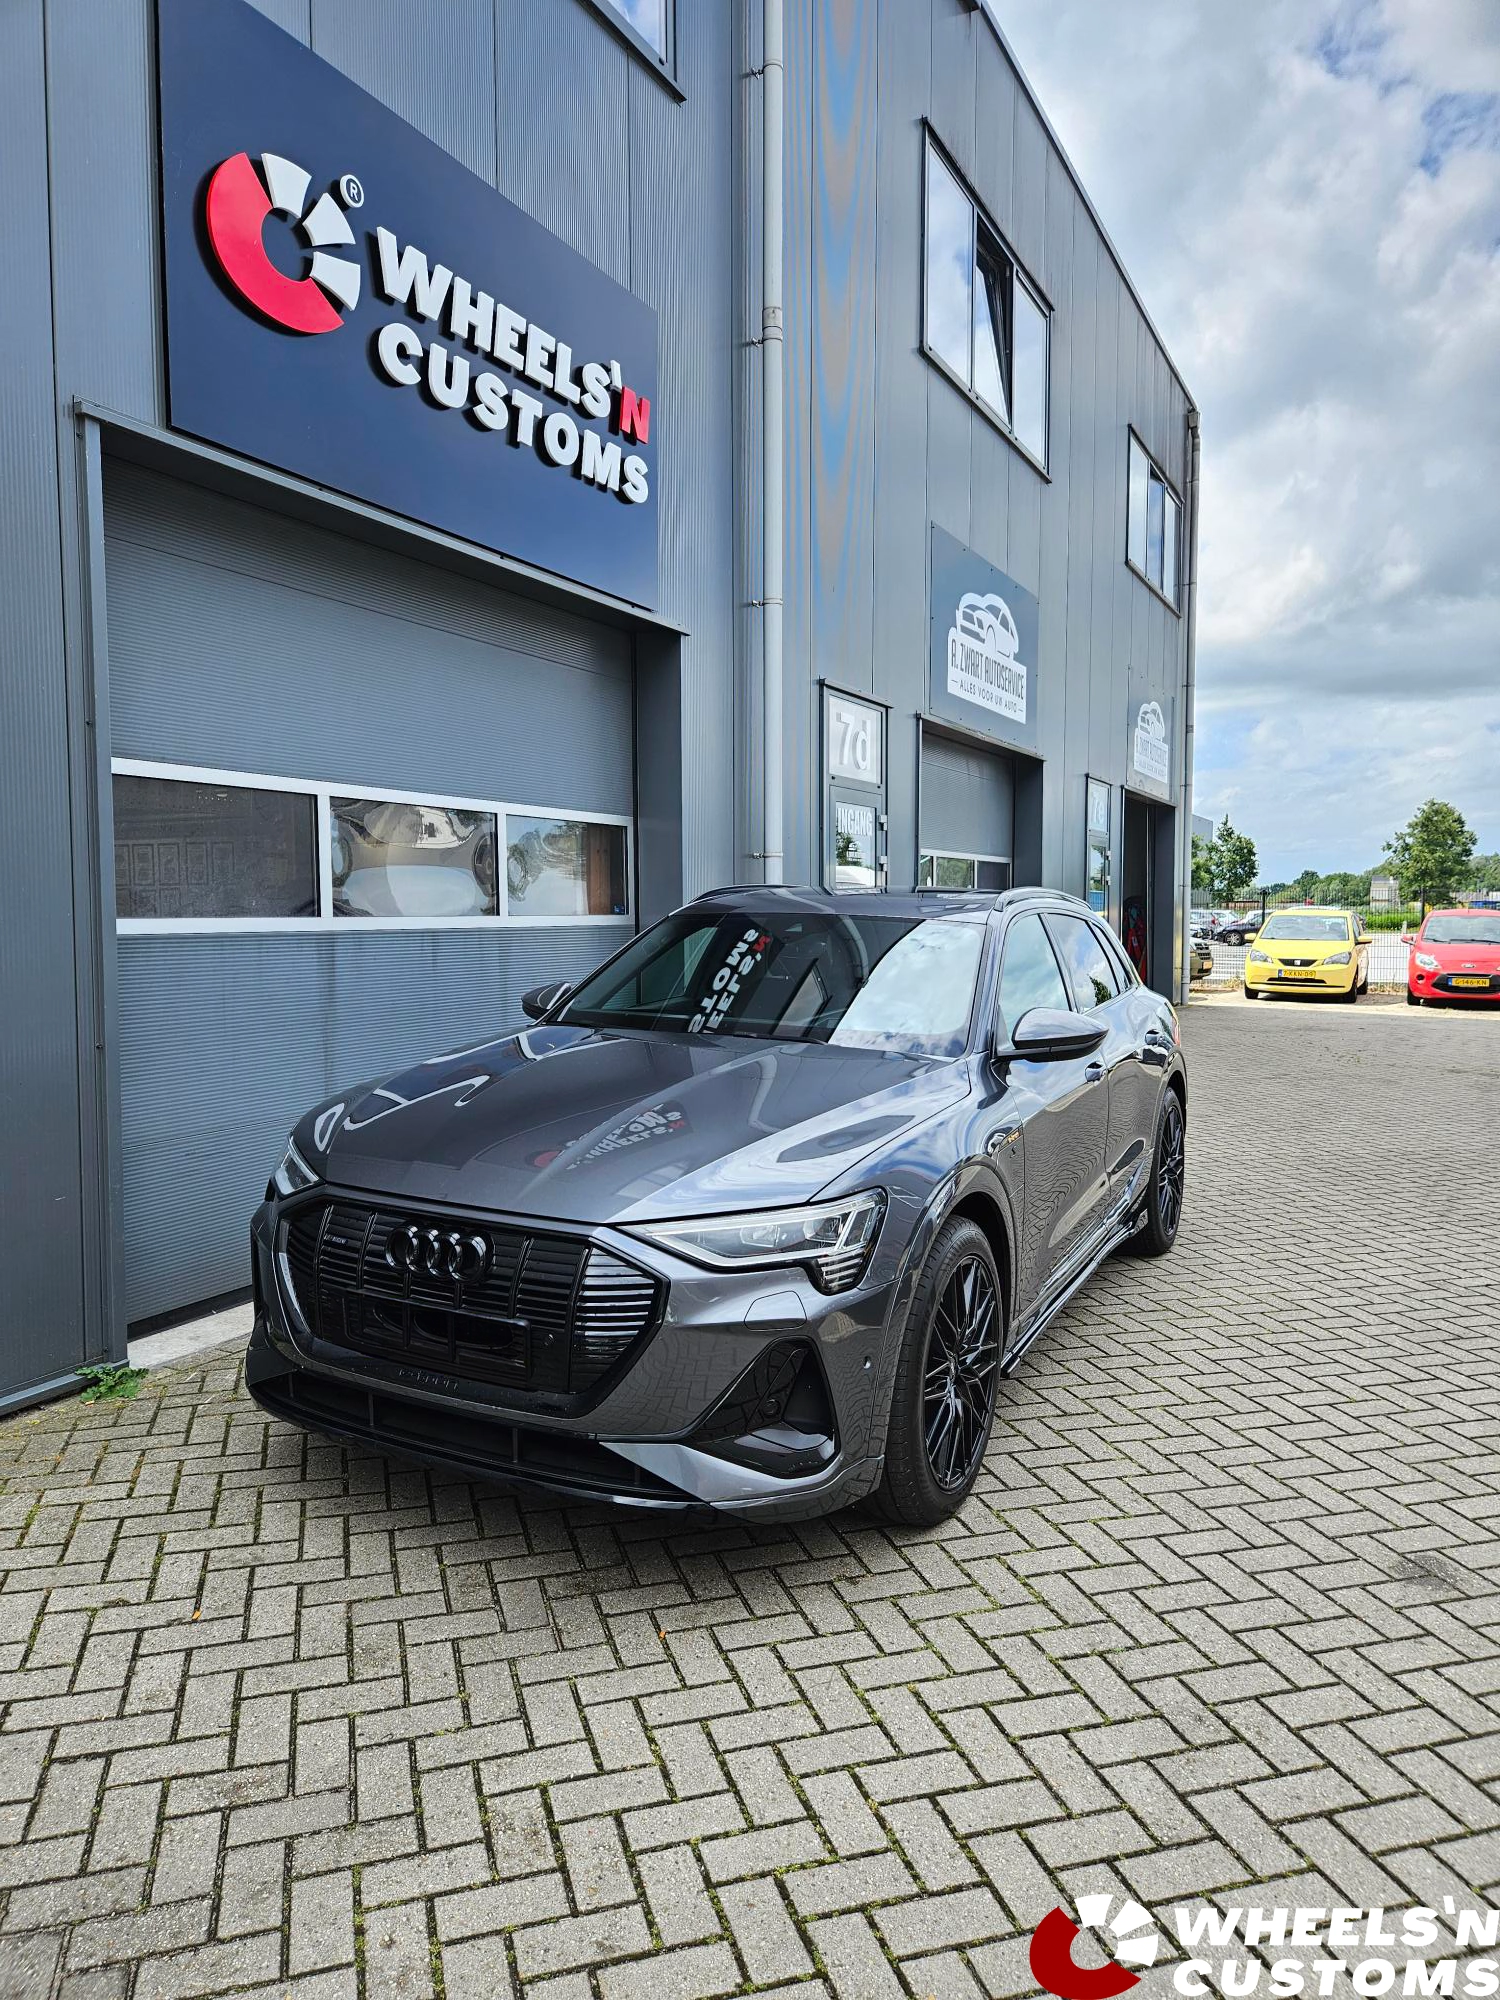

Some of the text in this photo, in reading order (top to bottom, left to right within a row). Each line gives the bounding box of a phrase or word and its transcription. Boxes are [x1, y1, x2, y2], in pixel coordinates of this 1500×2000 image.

[376, 226, 650, 444] WHEELS'N
[378, 322, 650, 503] CUSTOMS
[960, 643, 983, 680] ZWART
[985, 656, 1024, 700] AUTOSERVICE
[960, 680, 976, 695] ALLES
[978, 687, 993, 701] VOOR
[837, 711, 871, 770] 7d
[836, 806, 873, 836] INGANG
